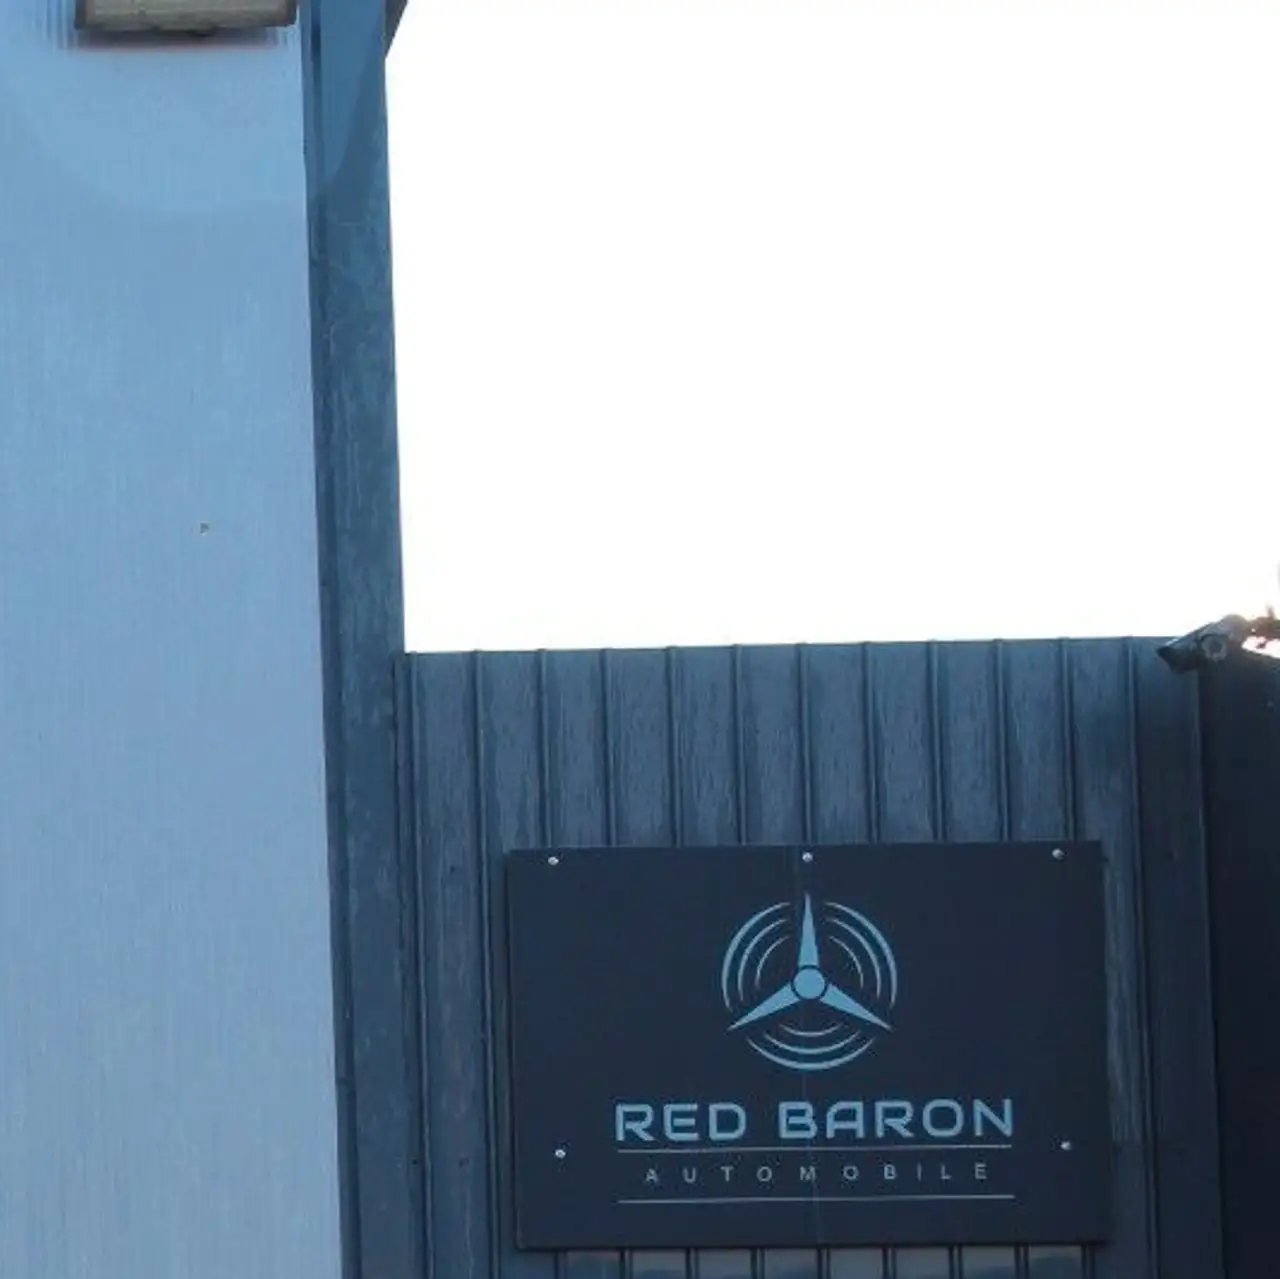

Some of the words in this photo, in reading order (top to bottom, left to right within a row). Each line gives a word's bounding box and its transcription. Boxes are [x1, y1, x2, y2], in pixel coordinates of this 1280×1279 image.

[615, 1102, 747, 1143] RED
[778, 1099, 1014, 1140] BARON
[645, 1163, 989, 1184] AUTOMOBILE
